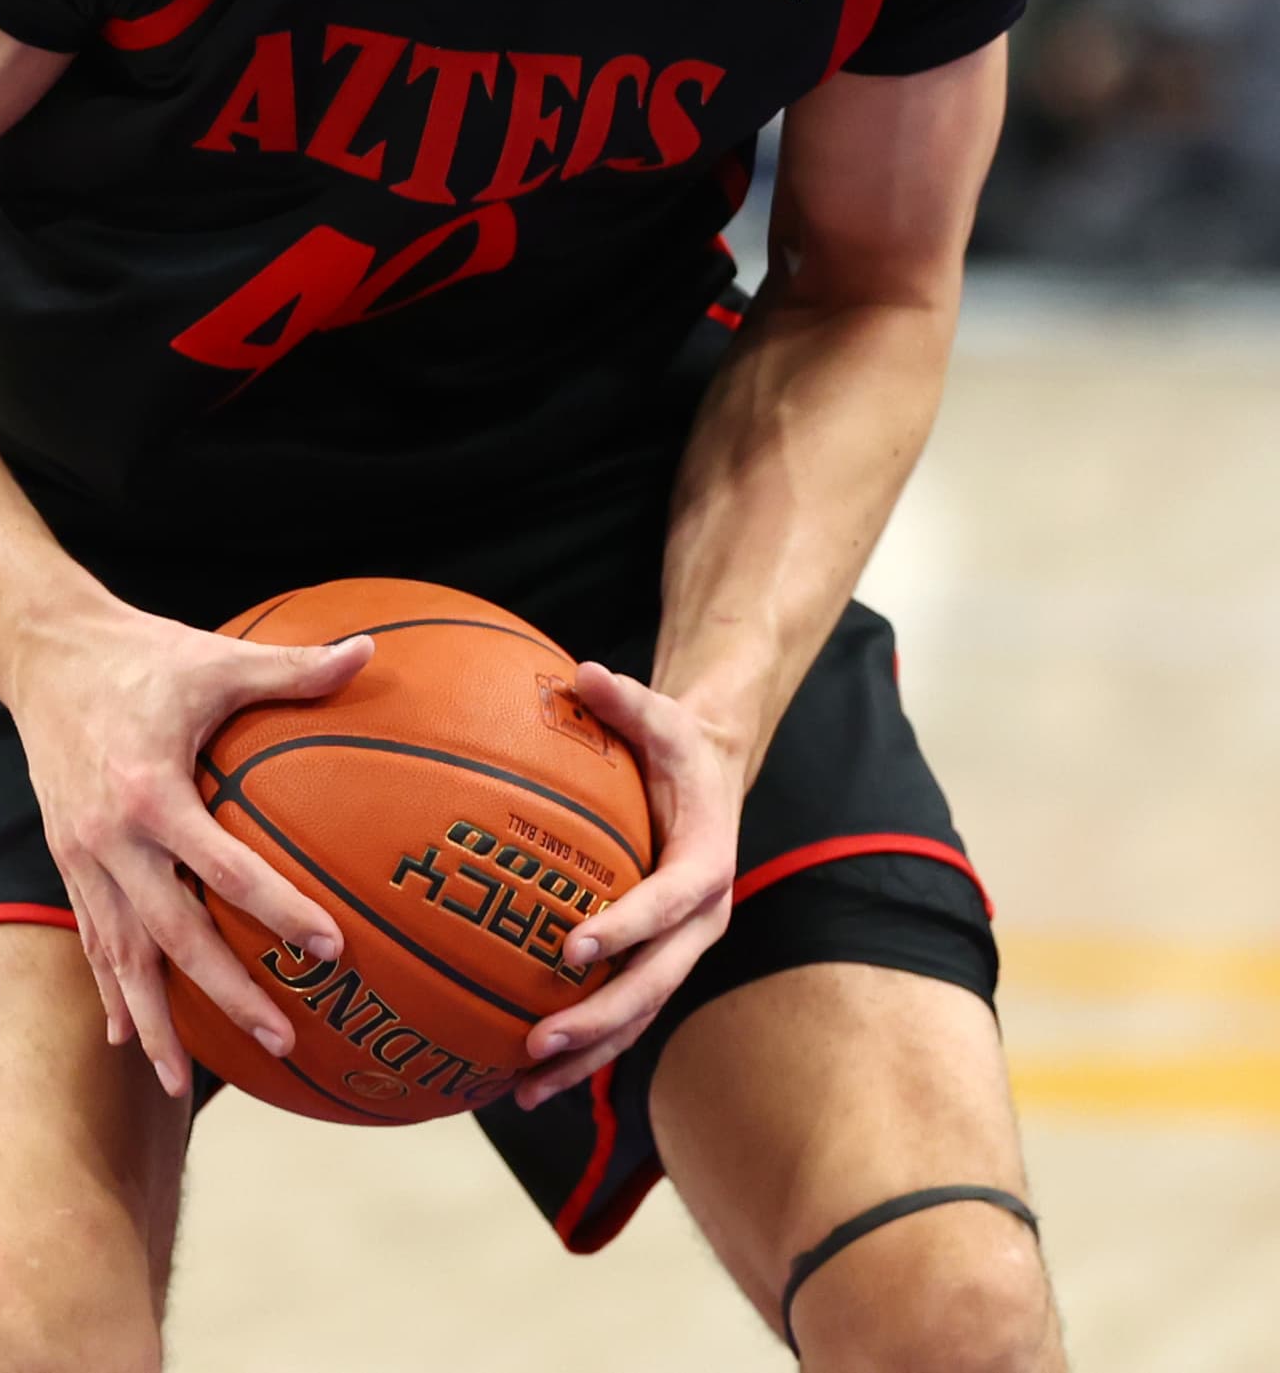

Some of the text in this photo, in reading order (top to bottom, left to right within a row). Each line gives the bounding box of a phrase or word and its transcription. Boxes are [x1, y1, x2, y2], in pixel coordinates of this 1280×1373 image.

[191, 25, 726, 205] AZTECS
[170, 201, 518, 372] 40
[388, 845, 594, 988] GACY
[507, 811, 616, 889] OFFICIAL GAME BALL
[259, 938, 513, 1102] PALDING
